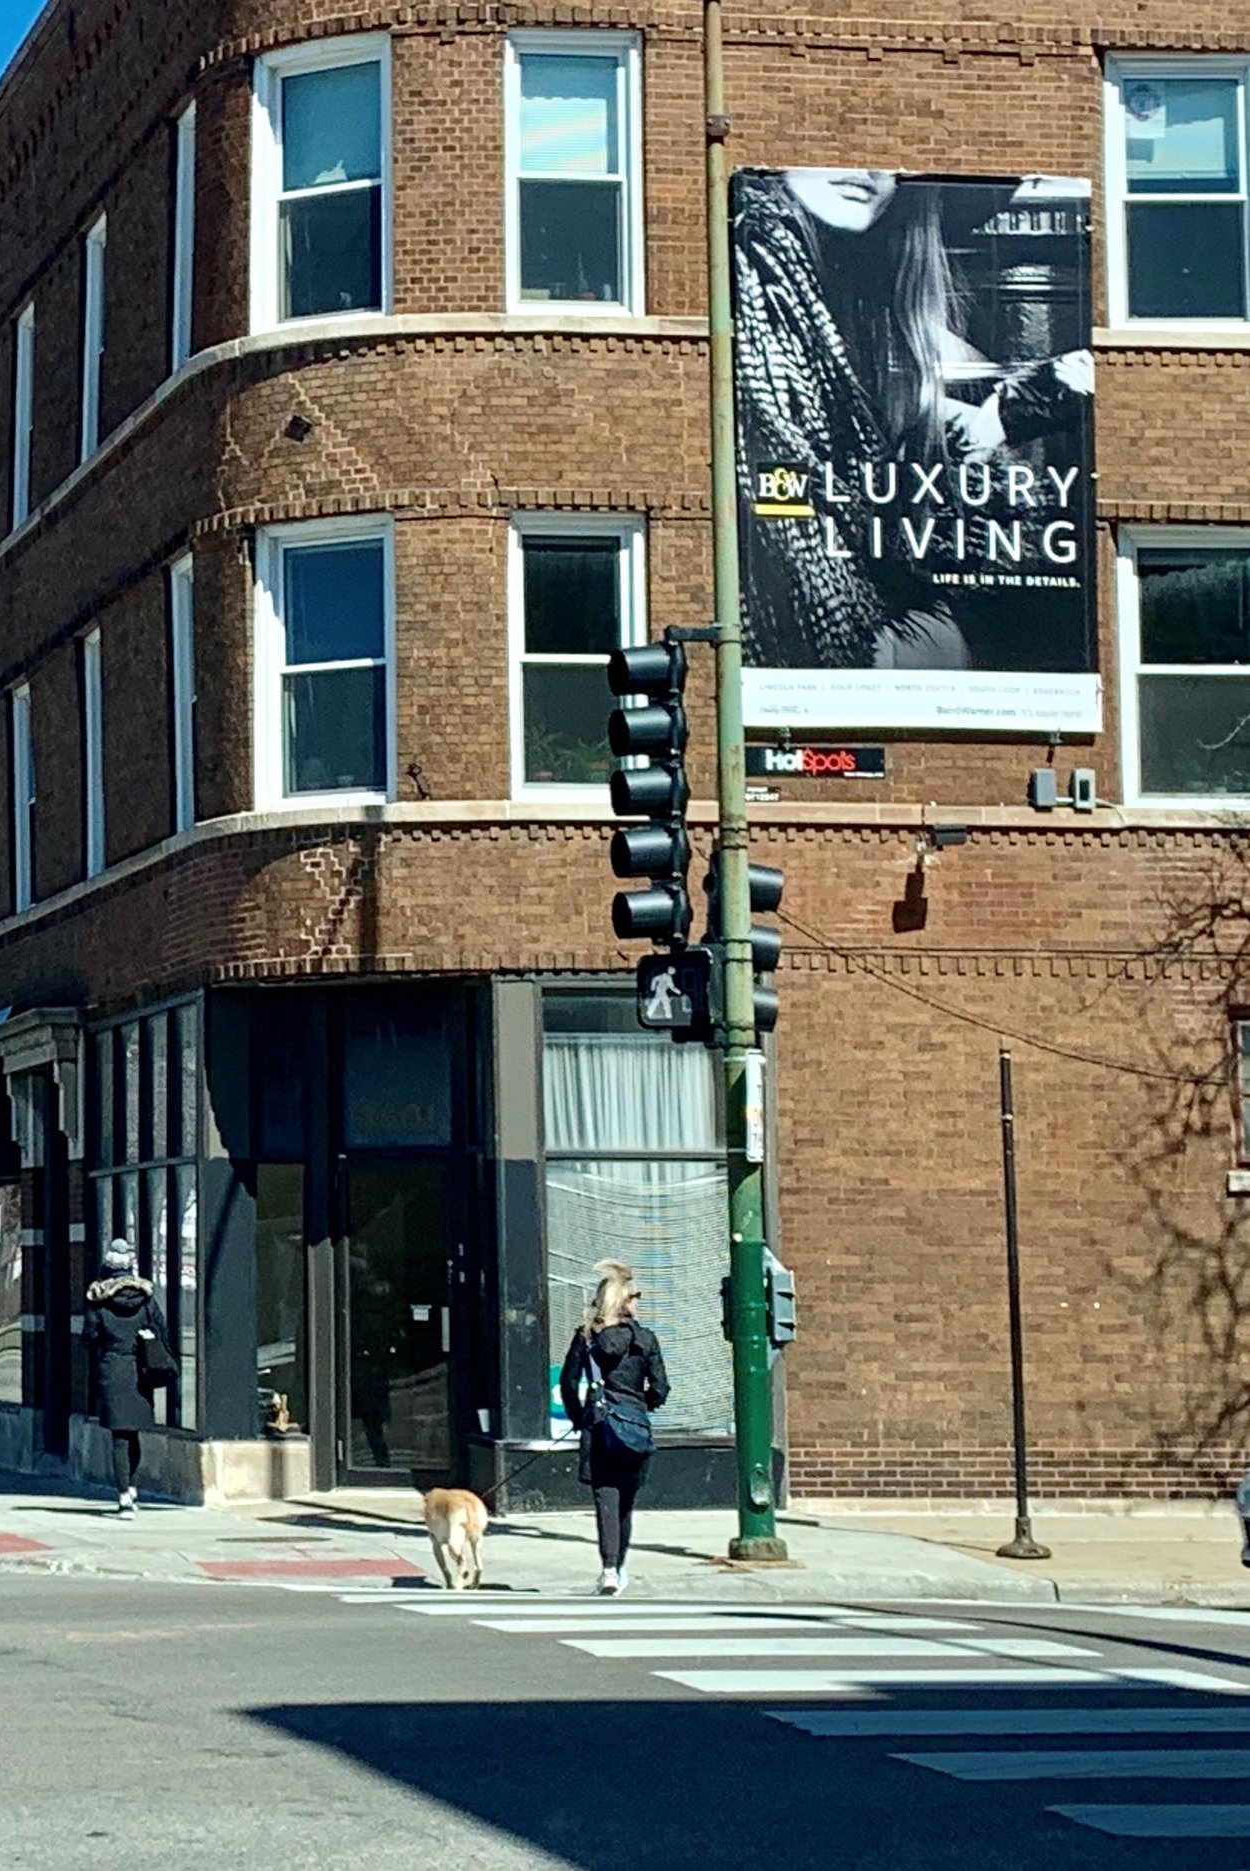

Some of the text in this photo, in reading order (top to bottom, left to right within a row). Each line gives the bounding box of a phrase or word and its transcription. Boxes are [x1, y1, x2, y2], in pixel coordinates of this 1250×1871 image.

[758, 467, 808, 501] B&W
[825, 462, 1079, 508] LUXURY
[825, 516, 1077, 564] LIVING
[932, 573, 1082, 588] LIFE IS IN THE DETAILS.
